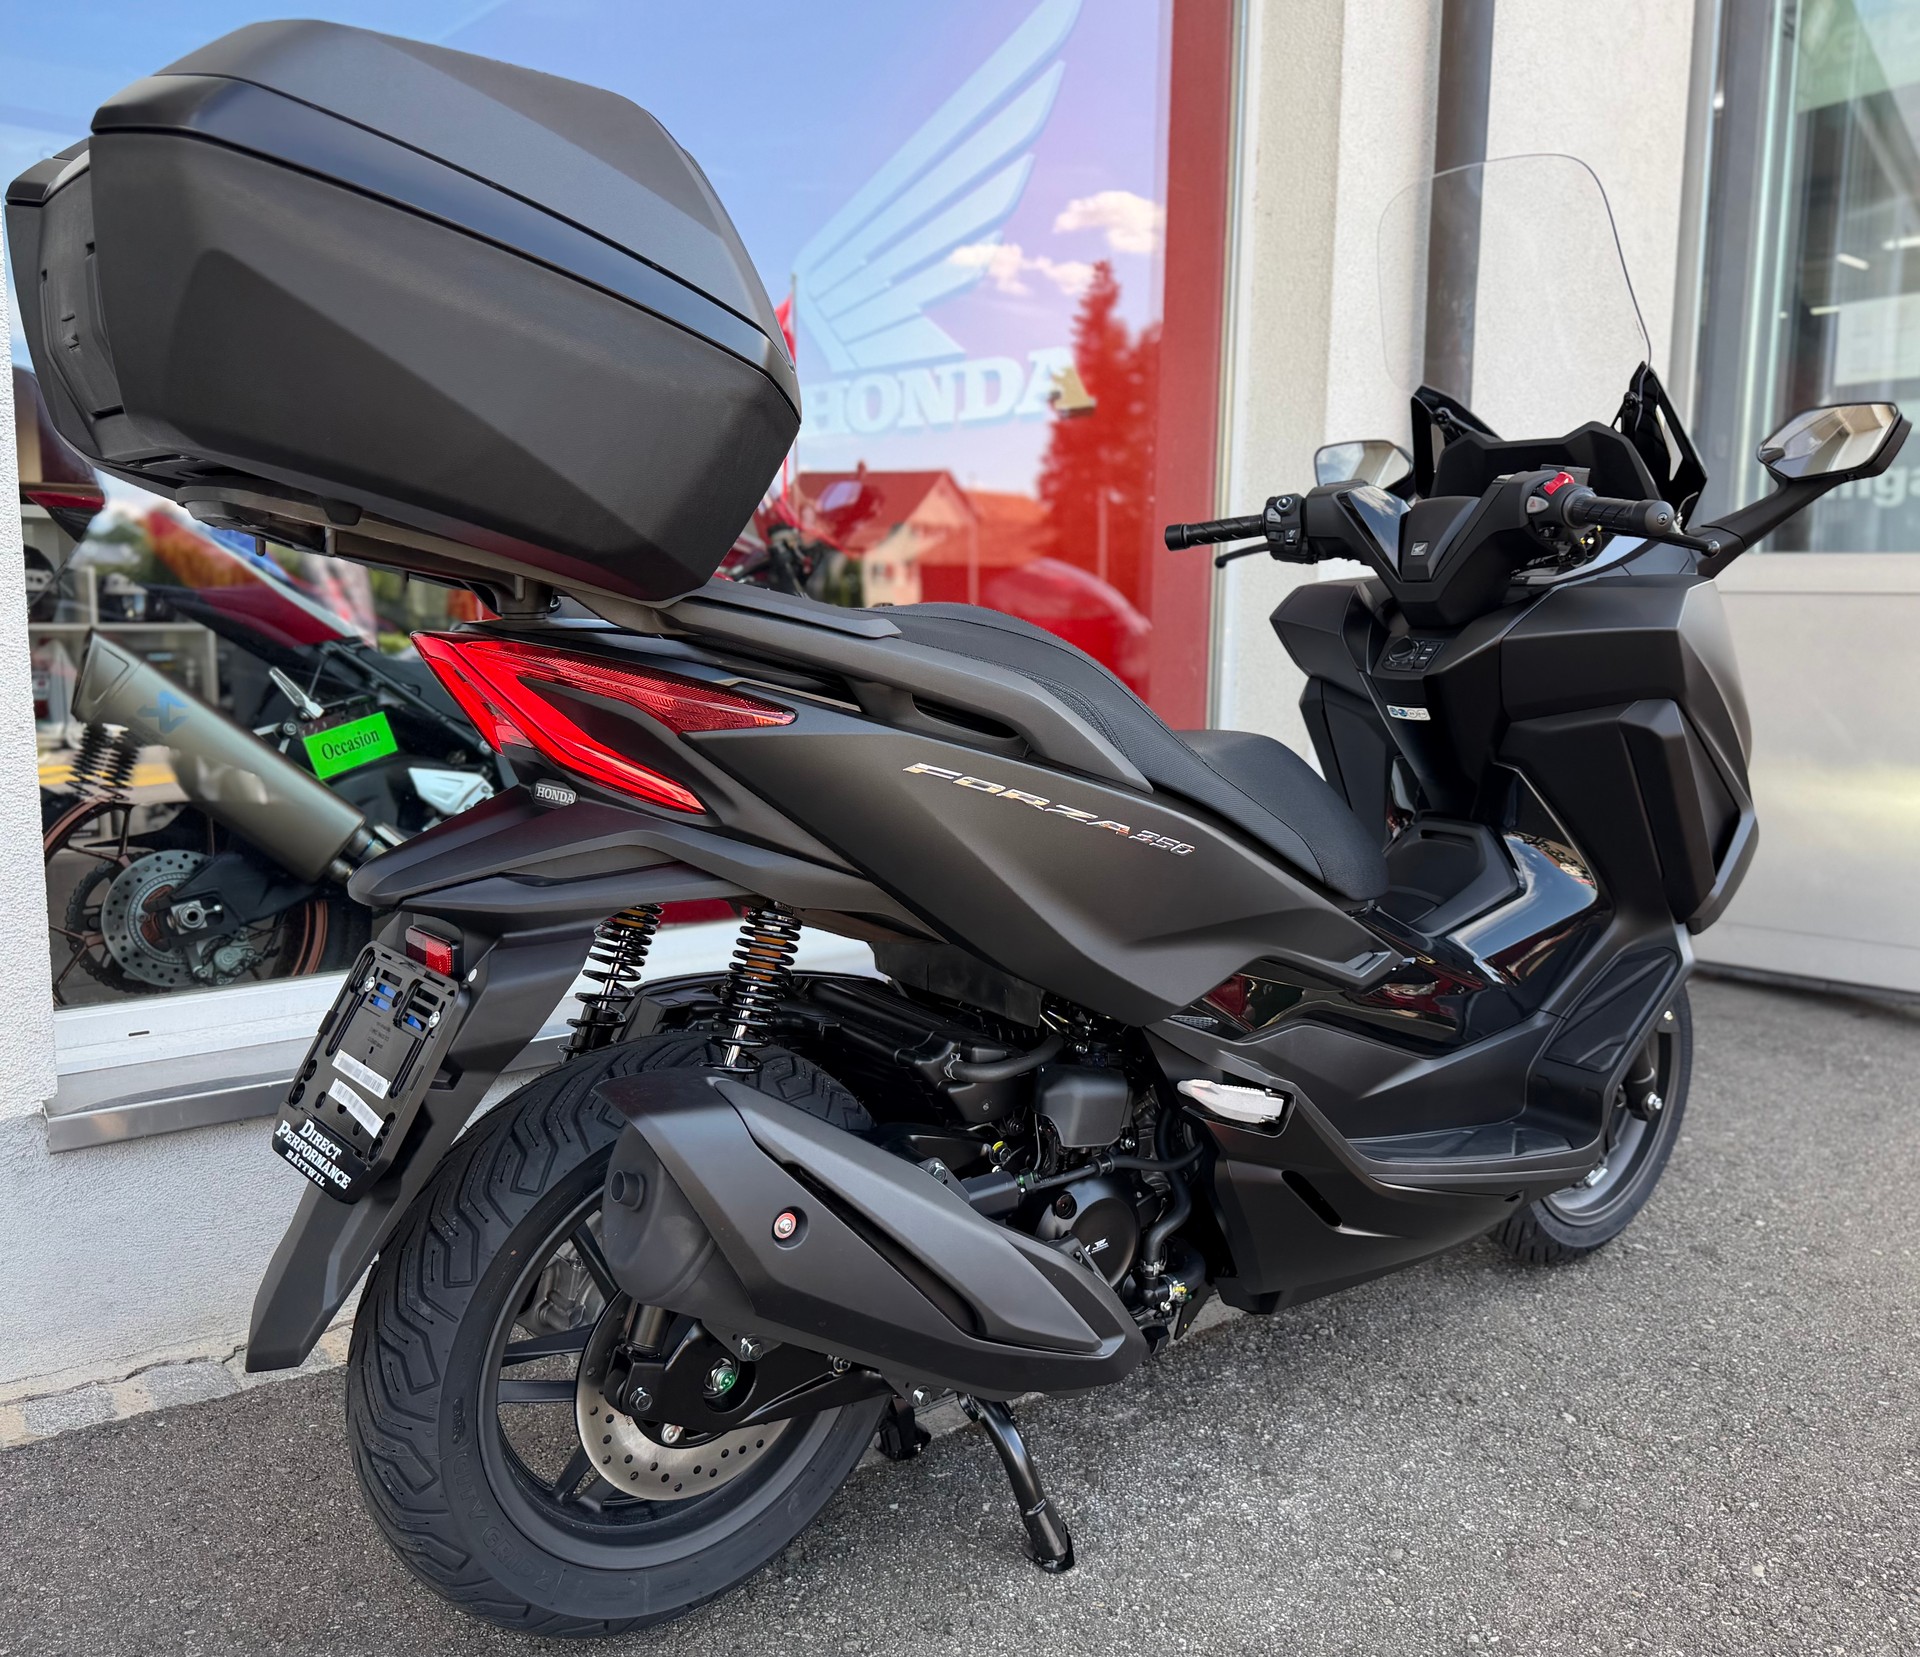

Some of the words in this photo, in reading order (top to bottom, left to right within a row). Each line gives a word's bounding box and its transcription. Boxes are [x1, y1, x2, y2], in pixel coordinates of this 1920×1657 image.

[800, 346, 1095, 438] HONDA
[321, 729, 380, 760] Occasion
[536, 786, 576, 805] HONDA
[903, 762, 1131, 836] FORZA
[1128, 830, 1195, 856] 350
[275, 1119, 352, 1190] PERFORMANCE
[298, 1119, 343, 1161] DIRECT
[285, 1150, 326, 1187] BATTWIL
[453, 1451, 489, 1520] CITY
[481, 1525, 535, 1577] GRIP
